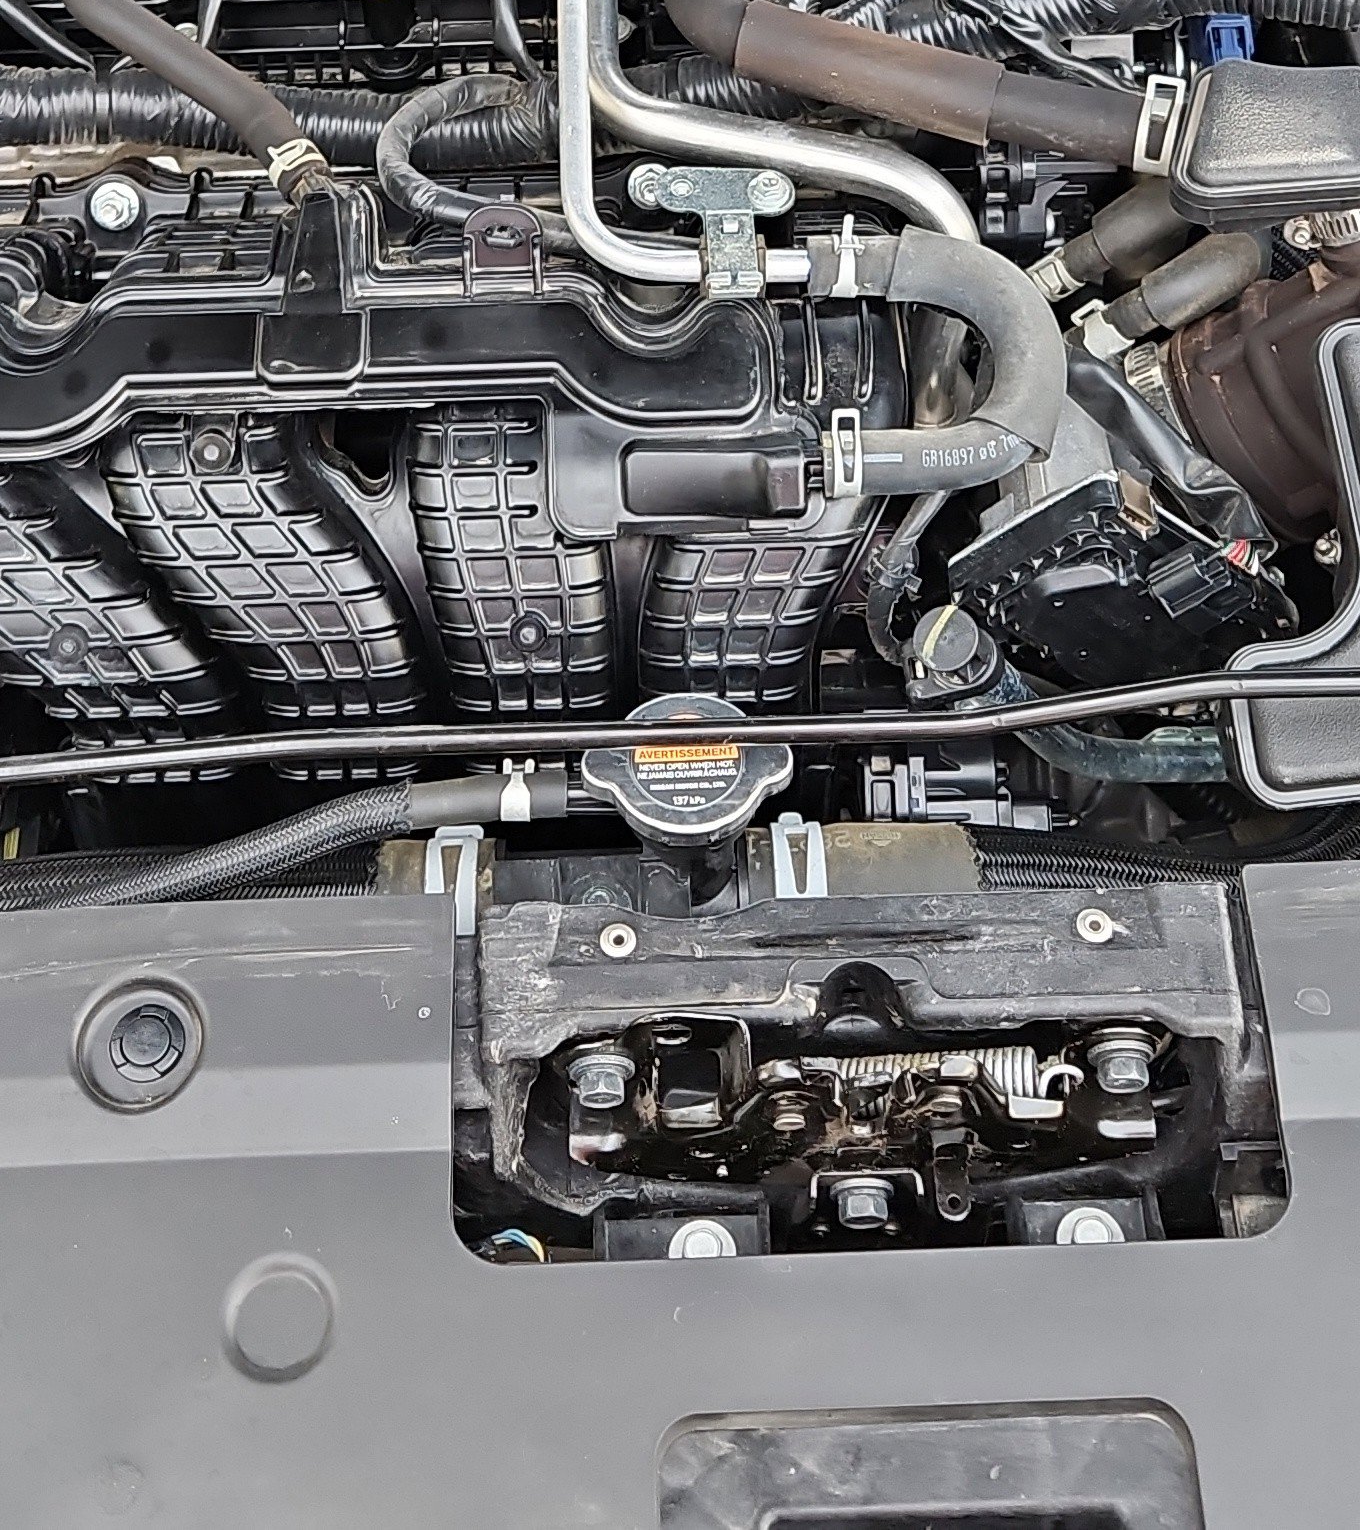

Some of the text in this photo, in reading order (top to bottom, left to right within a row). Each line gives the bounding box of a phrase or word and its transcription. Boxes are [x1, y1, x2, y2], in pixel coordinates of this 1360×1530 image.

[922, 446, 974, 467] GB16897
[639, 747, 733, 759] AVERTISSEMENT
[639, 763, 665, 771] NEVER
[667, 762, 690, 770] OPEN
[690, 761, 716, 770] WHEN
[672, 795, 706, 806] 137 kPa
